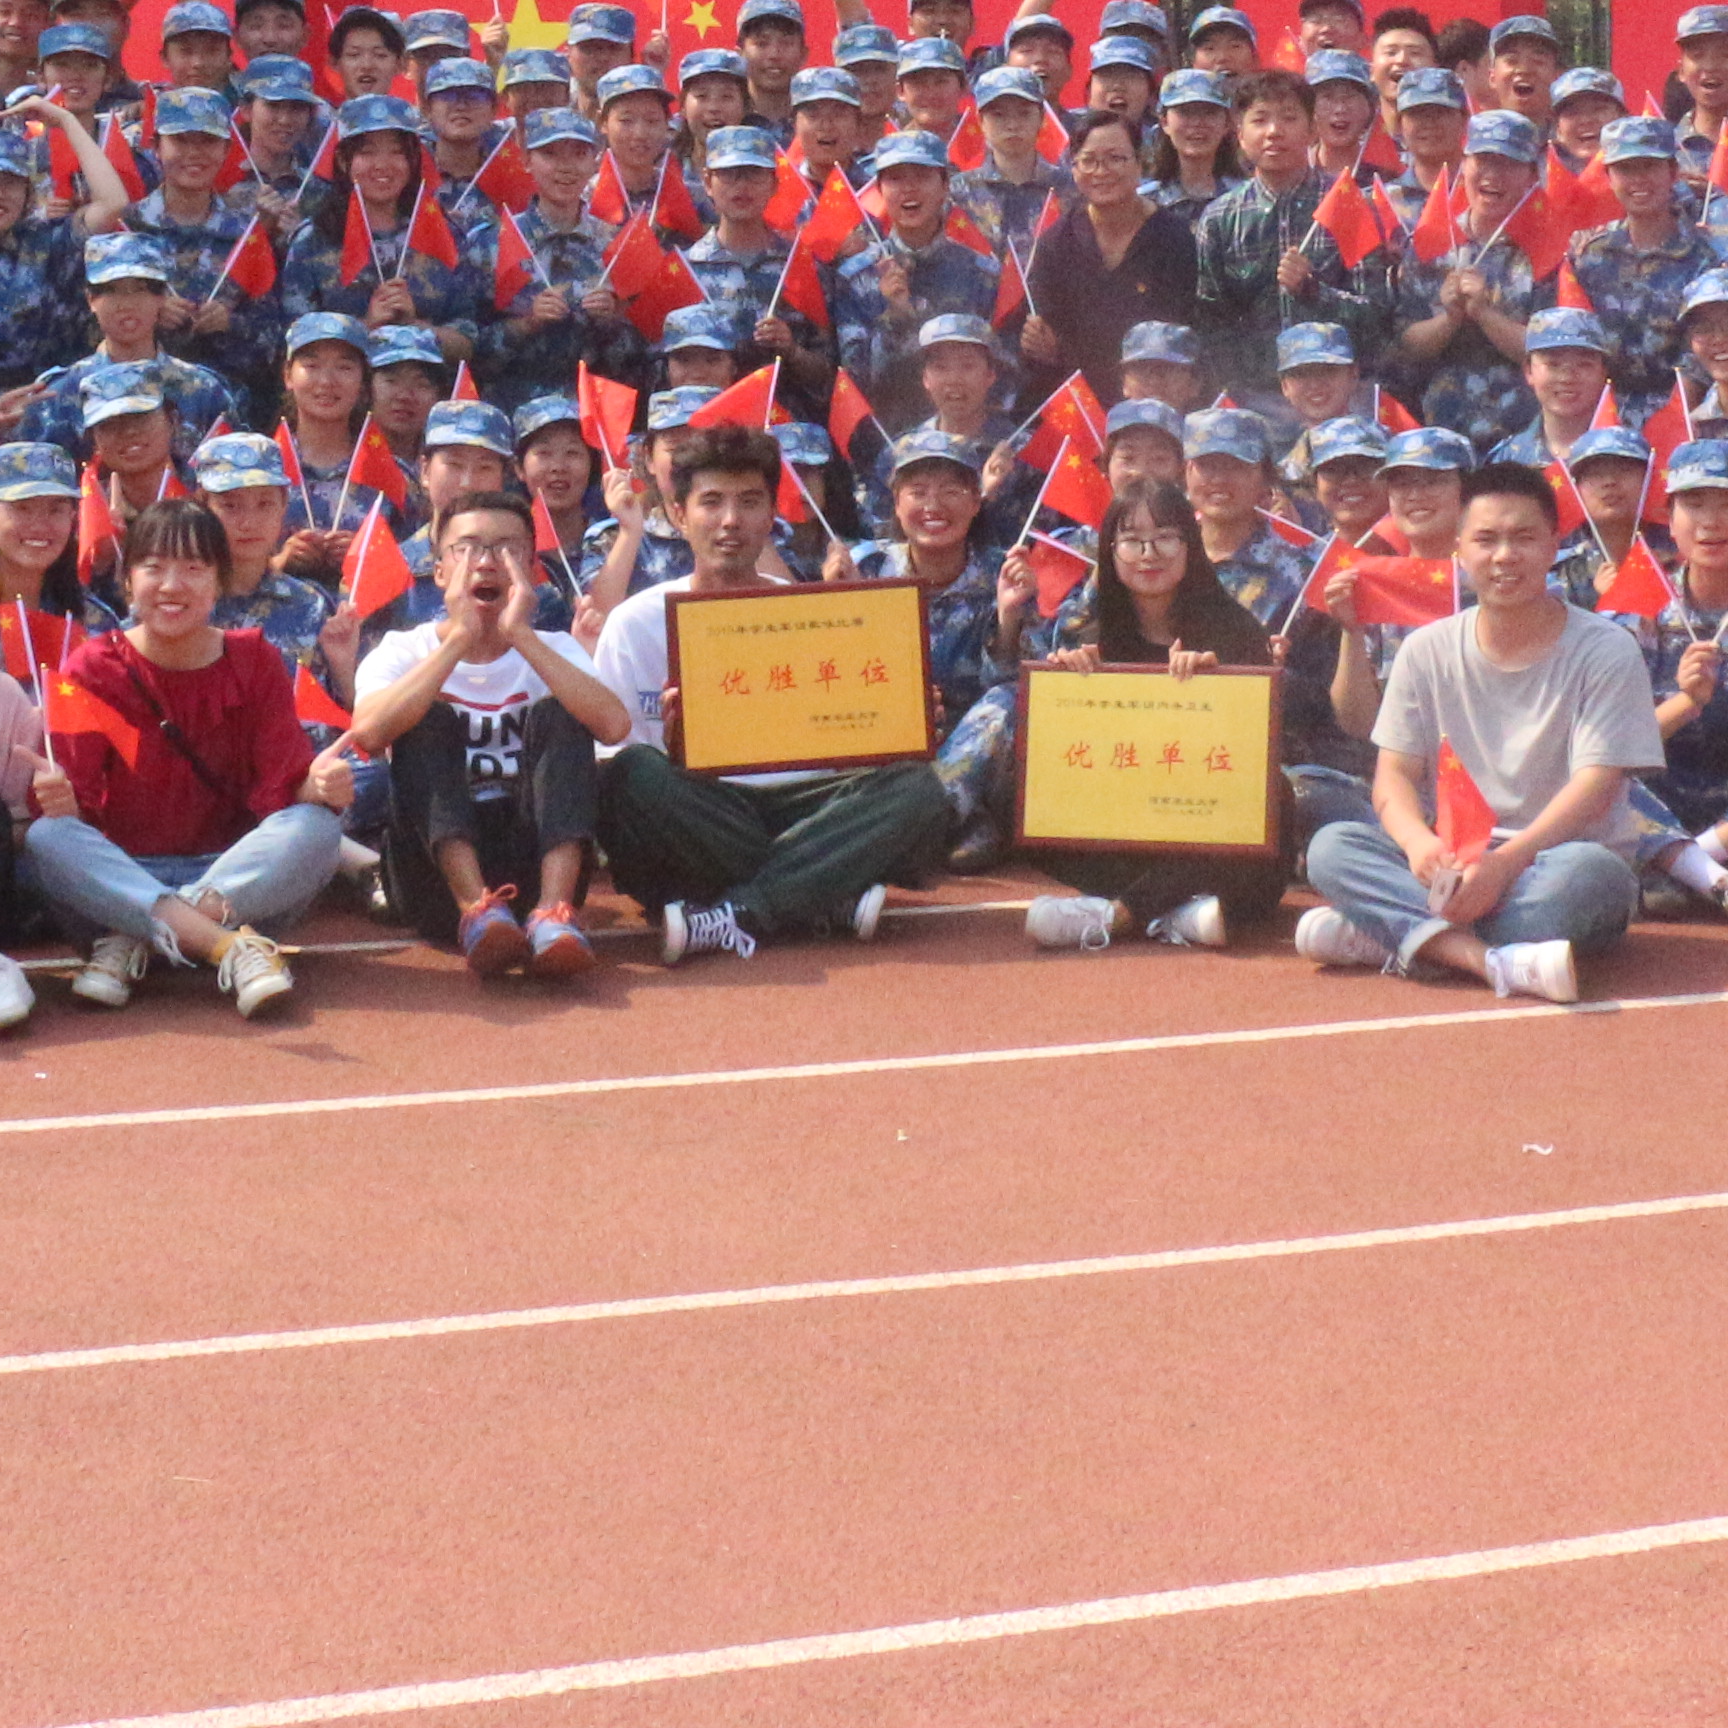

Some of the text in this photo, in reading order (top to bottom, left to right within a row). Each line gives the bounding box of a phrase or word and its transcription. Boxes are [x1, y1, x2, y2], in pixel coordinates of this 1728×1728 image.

[720, 657, 889, 697] 优胜单位
[1063, 740, 1233, 775] 优胜单位
